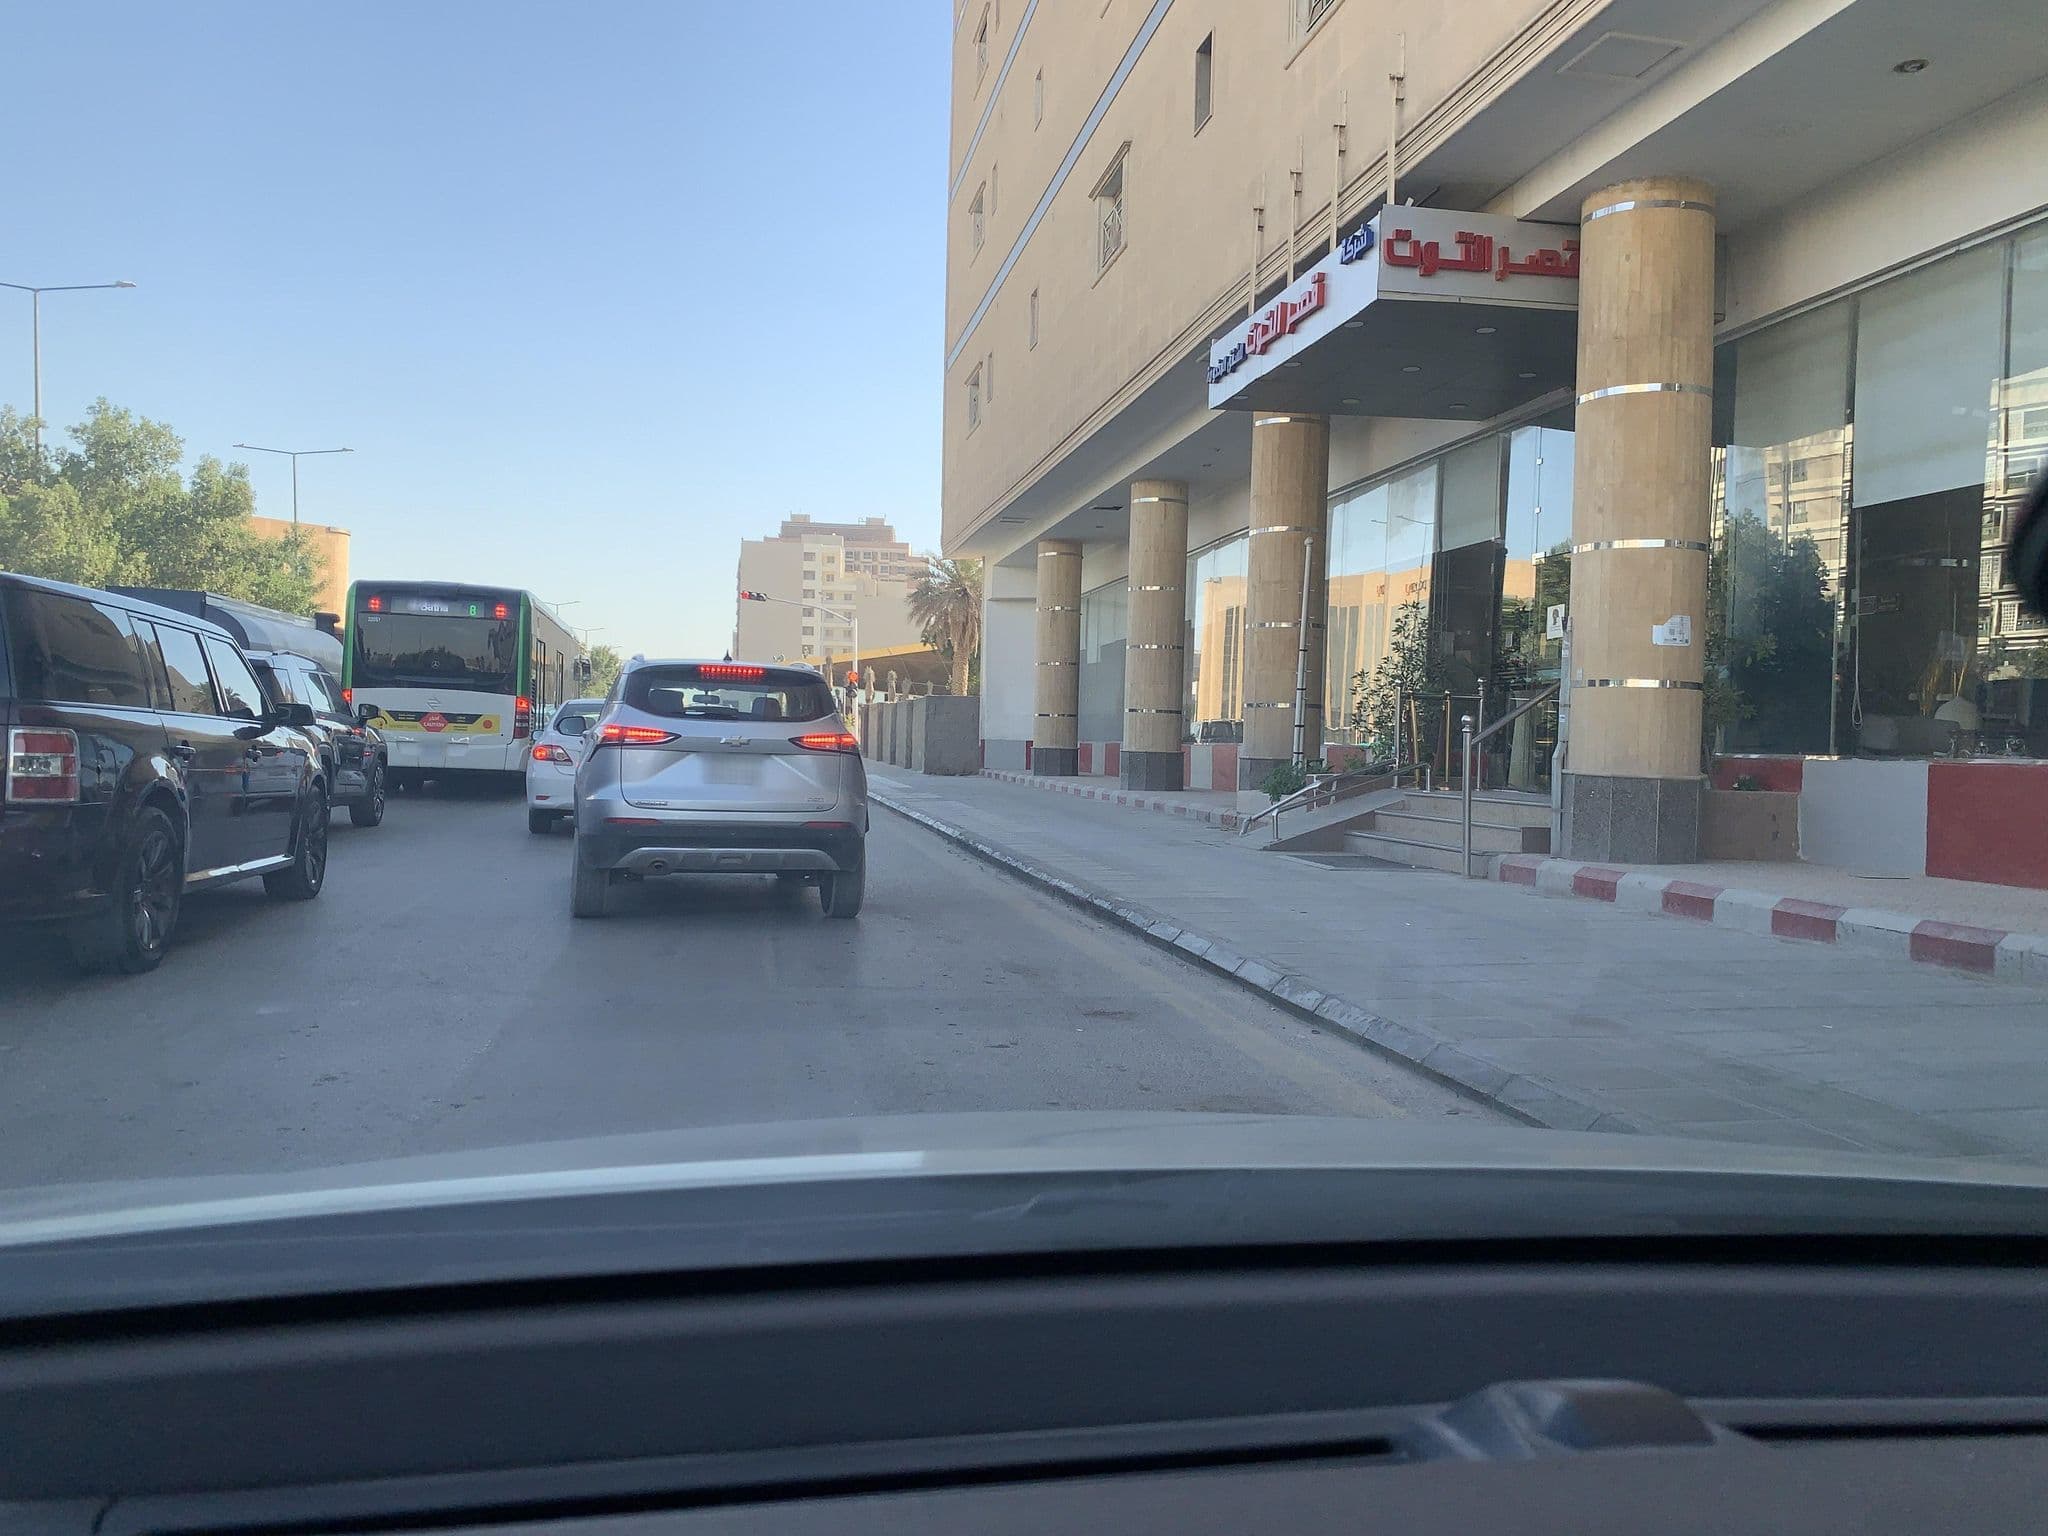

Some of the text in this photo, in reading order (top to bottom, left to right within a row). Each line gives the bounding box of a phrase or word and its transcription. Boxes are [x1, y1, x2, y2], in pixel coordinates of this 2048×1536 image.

[1384, 229, 1579, 281] قصر التوت
[1286, 272, 1327, 335] قصر
